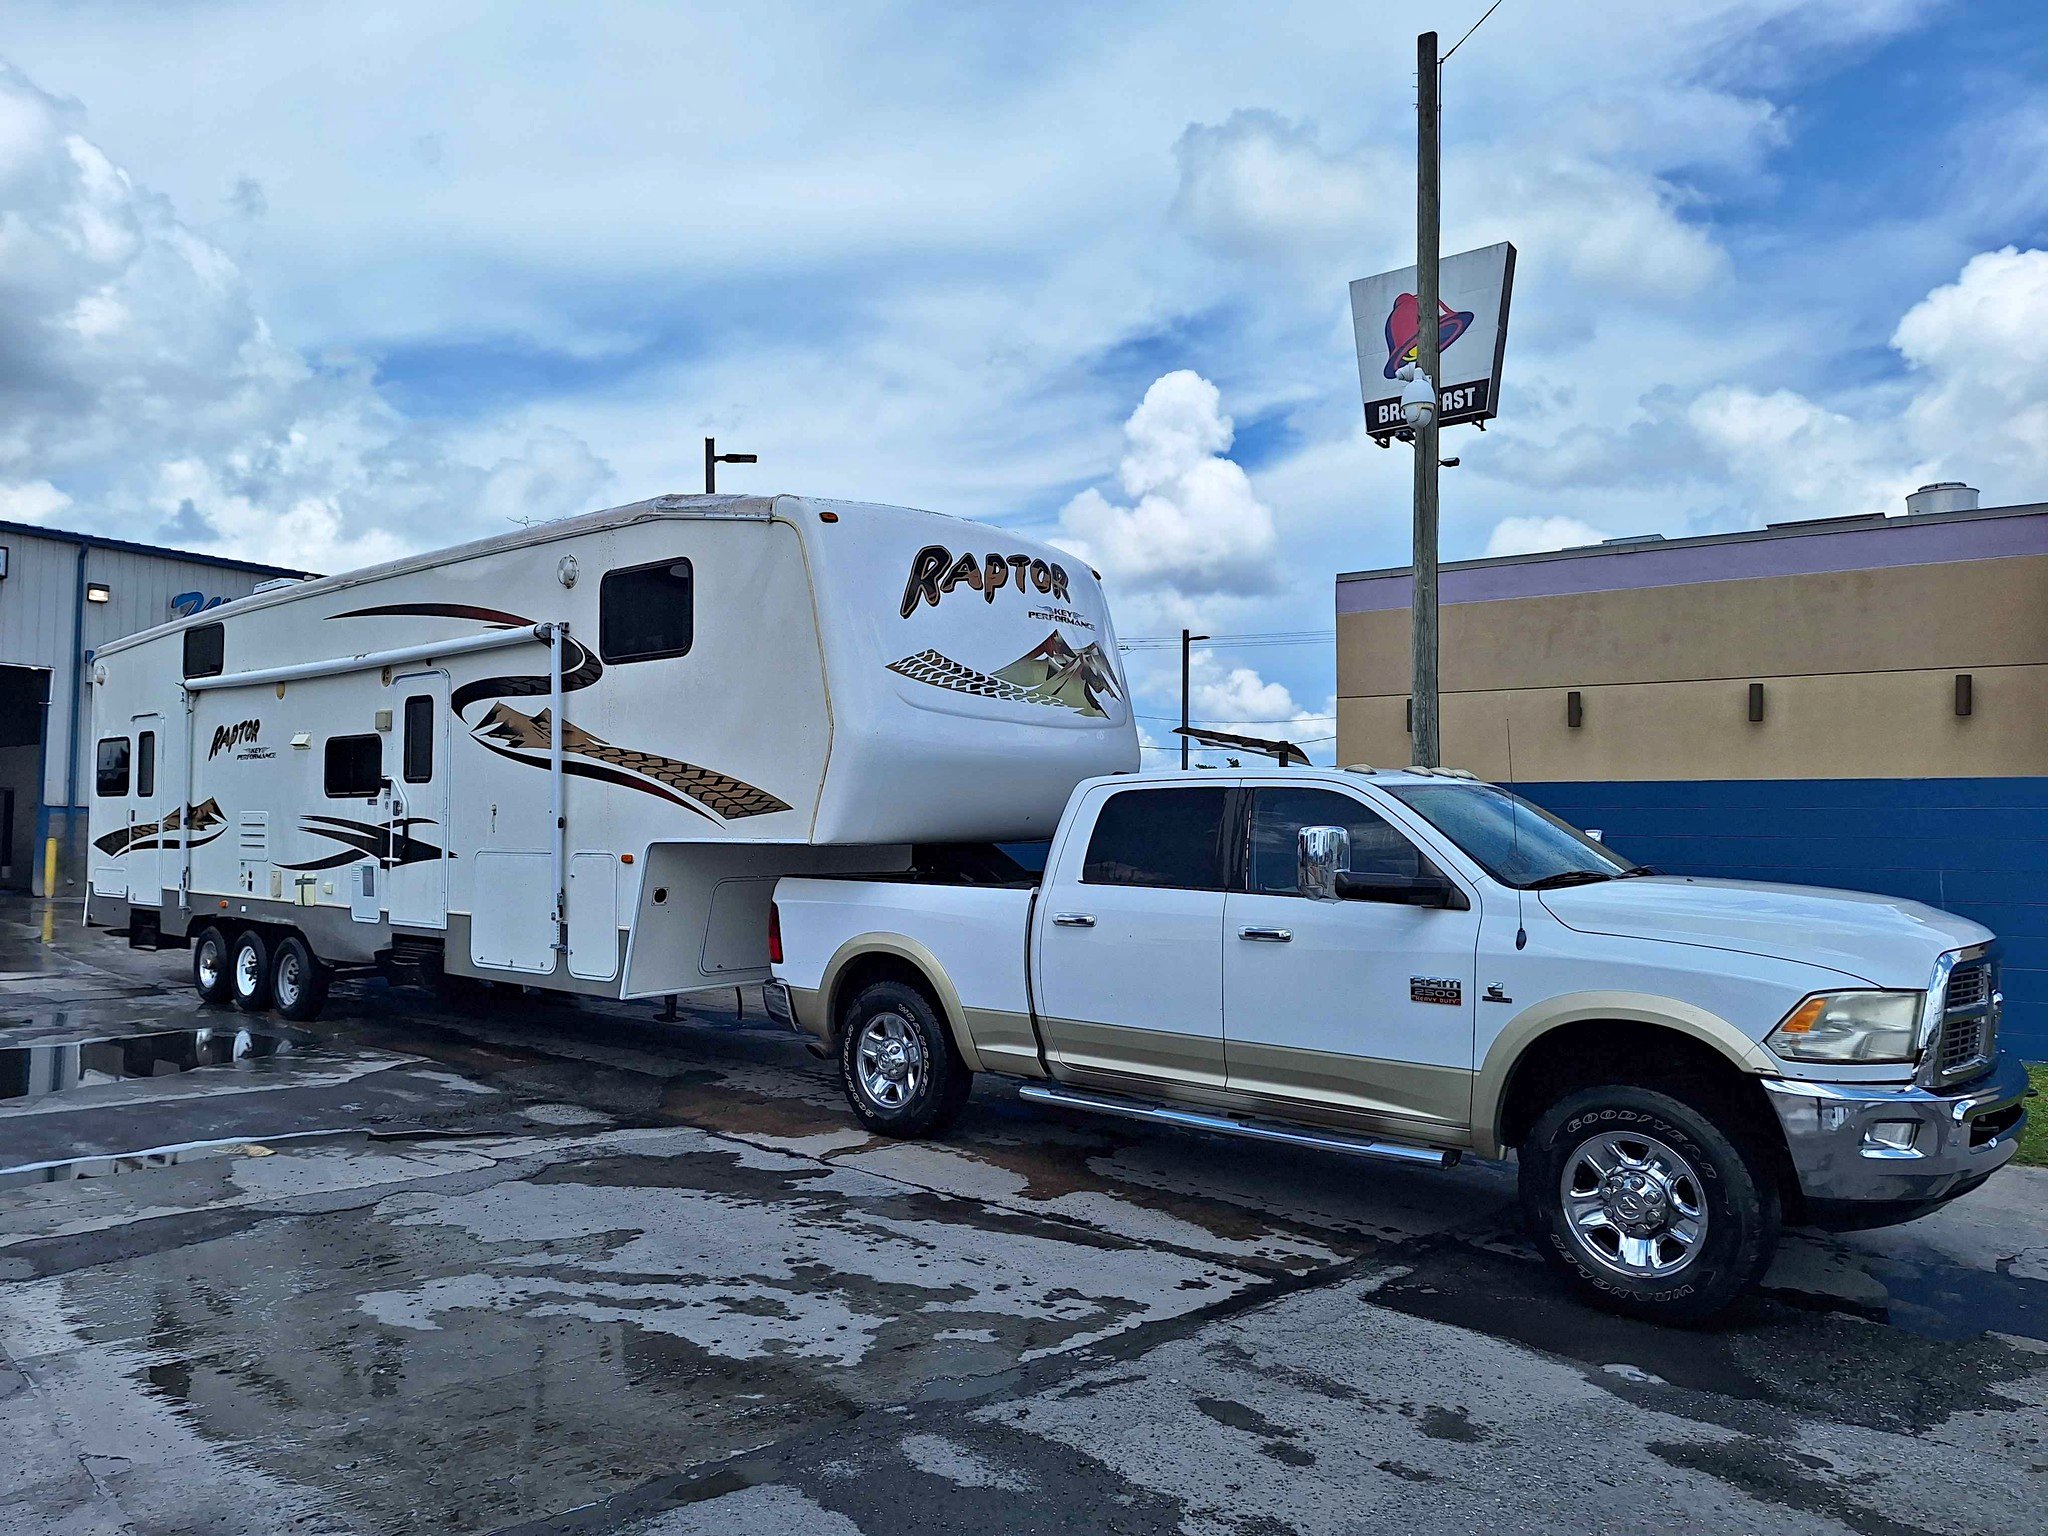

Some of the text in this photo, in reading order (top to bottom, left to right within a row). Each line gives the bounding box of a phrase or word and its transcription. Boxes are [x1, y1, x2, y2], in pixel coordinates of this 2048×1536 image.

[1378, 387, 1476, 424] BRAST
[899, 544, 1071, 620] RAPTOR
[1028, 611, 1096, 632] PERFORMANCE
[1054, 608, 1073, 617] KEY
[208, 718, 261, 762] RAPTOR
[1410, 975, 1462, 990] RAM
[1414, 988, 1457, 998] 2500
[1567, 1109, 1718, 1179] GOODYEAR
[1550, 1233, 1695, 1302] WRANGLER
